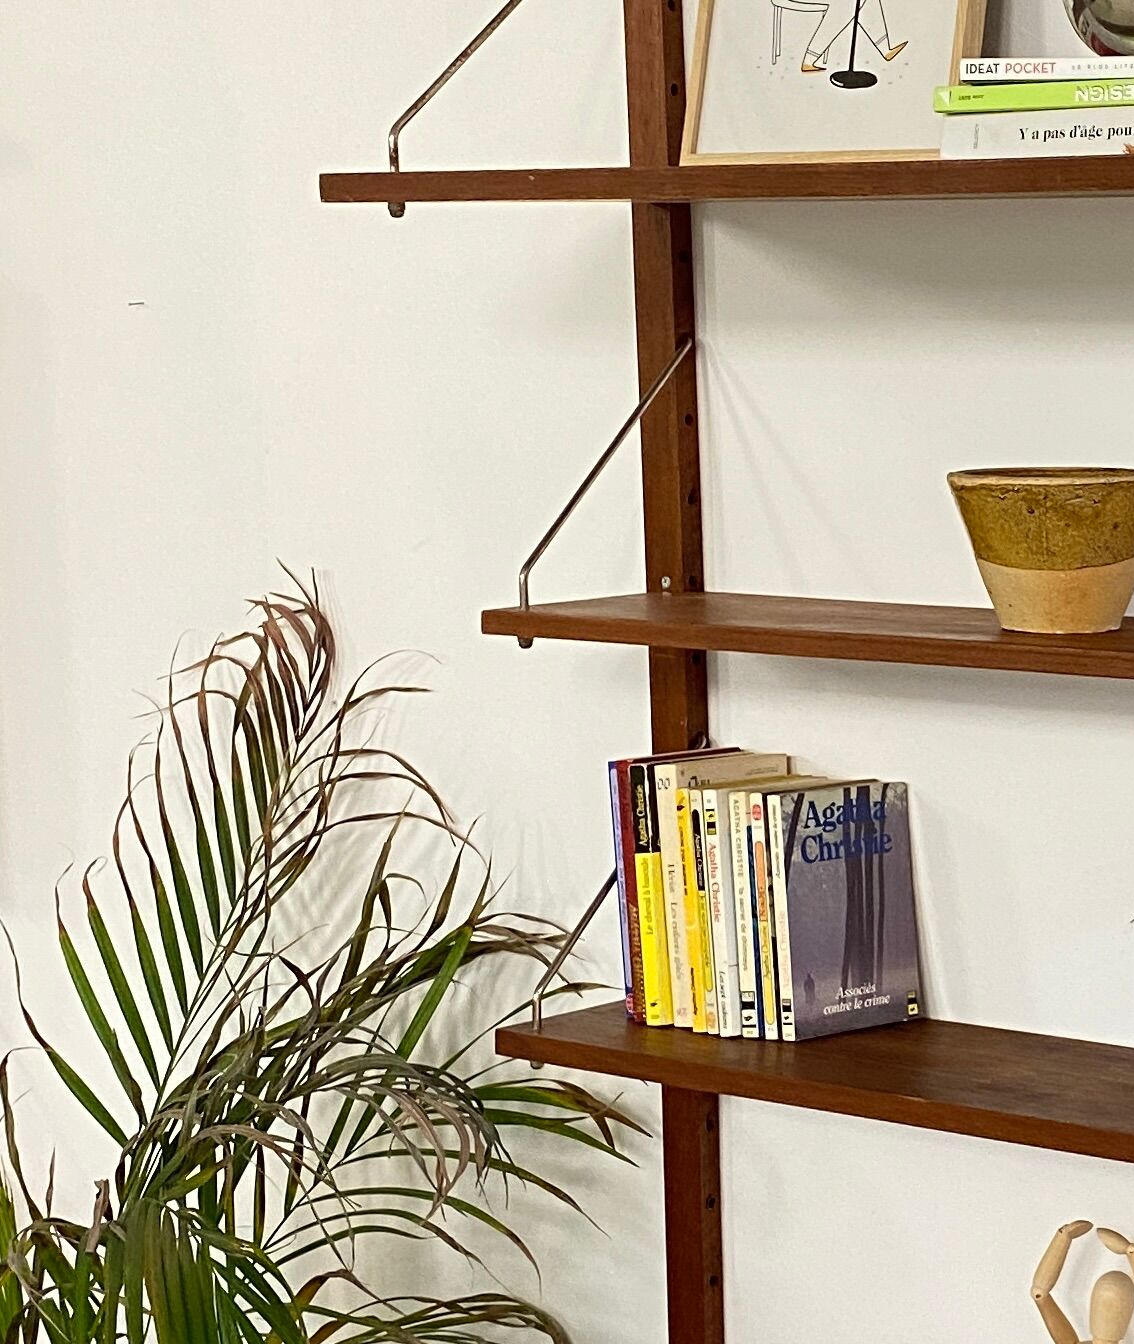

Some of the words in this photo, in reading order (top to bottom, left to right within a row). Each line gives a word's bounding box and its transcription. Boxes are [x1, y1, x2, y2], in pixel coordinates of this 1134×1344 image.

[966, 63, 1000, 75] IDEAT
[1005, 62, 1057, 75] POCKET
[1019, 128, 1029, 140] Y
[1031, 130, 1039, 140] a
[1043, 128, 1066, 143] pas
[1069, 125, 1103, 142] d'âge
[733, 799, 741, 834] AGATHA
[708, 842, 719, 879] Agatha
[736, 837, 744, 877] CHRISTIE
[711, 882, 721, 923] Christie
[823, 1000, 853, 1016] contre
[854, 997, 863, 1010] le
[864, 994, 891, 1009] crime
[835, 982, 877, 1000] Associés
